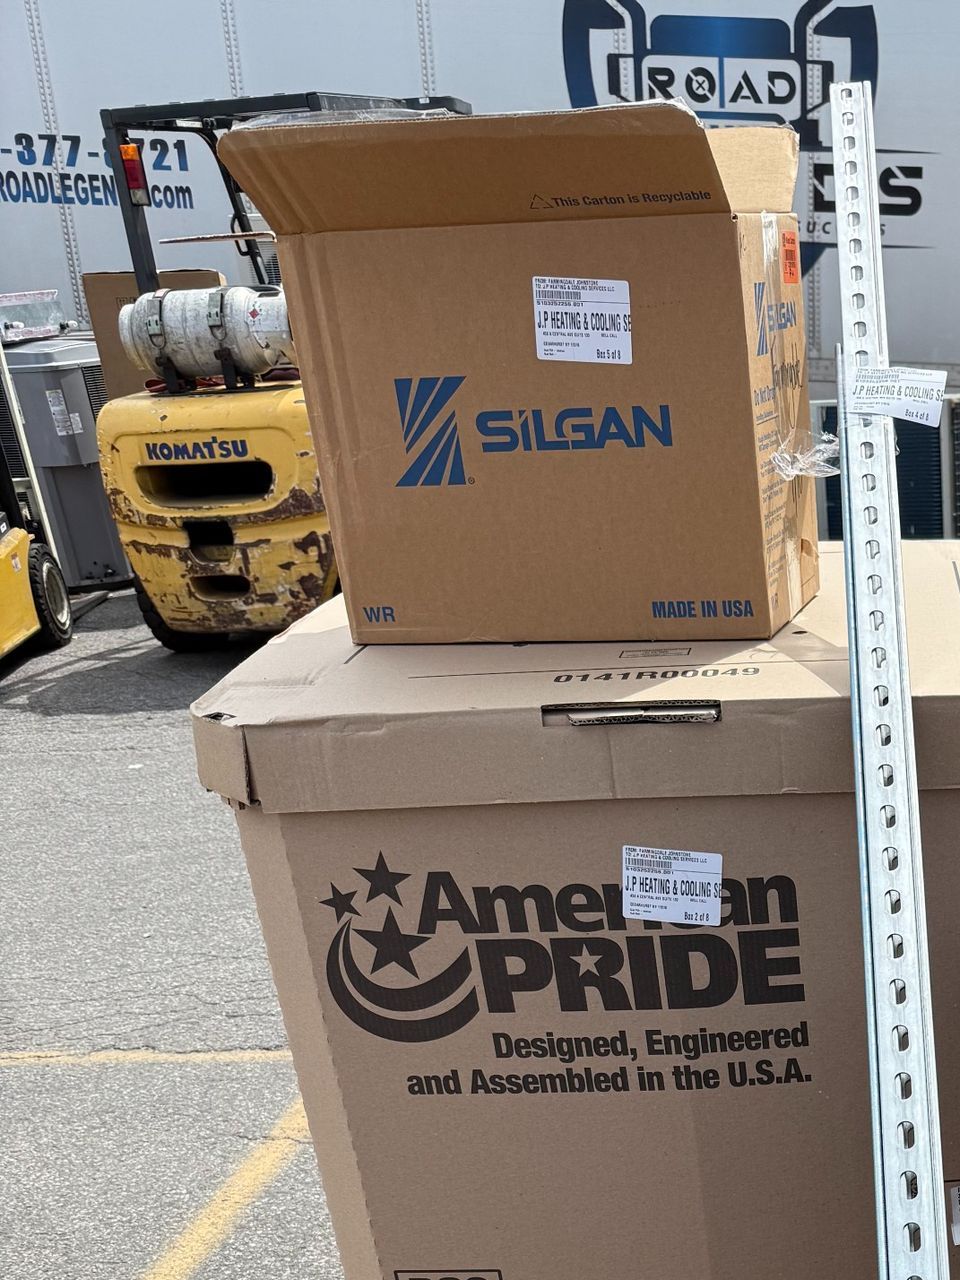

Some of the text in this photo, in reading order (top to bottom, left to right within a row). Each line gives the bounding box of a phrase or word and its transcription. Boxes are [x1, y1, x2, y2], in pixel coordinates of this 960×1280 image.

[647, 66, 797, 104] ROAD
[552, 190, 712, 208] This Carton is Recyclable
[537, 310, 549, 329] J.P
[551, 310, 581, 330] HEATING
[583, 312, 588, 331] &
[591, 313, 621, 332] COOLING
[607, 350, 610, 359] 5
[865, 385, 896, 397] HEATING
[896, 386, 902, 397] &
[904, 386, 934, 401] COOLING
[475, 404, 673, 453] SILGAN
[145, 436, 248, 460] KOMATSU
[363, 606, 396, 623] WR
[652, 599, 754, 618] MADE IN USA
[553, 667, 760, 683] 0141R00049
[626, 875, 637, 892] J.P
[640, 877, 670, 895] HEATING
[673, 879, 678, 895] &
[681, 880, 711, 898] COOLING
[417, 871, 799, 933] Ameran
[695, 913, 698, 921] 2
[706, 913, 709, 922] 8
[474, 928, 806, 1013] PRIDE
[492, 1021, 810, 1063] Designed, Engineered
[406, 1057, 812, 1095] and Assembled in the U.S.A.
